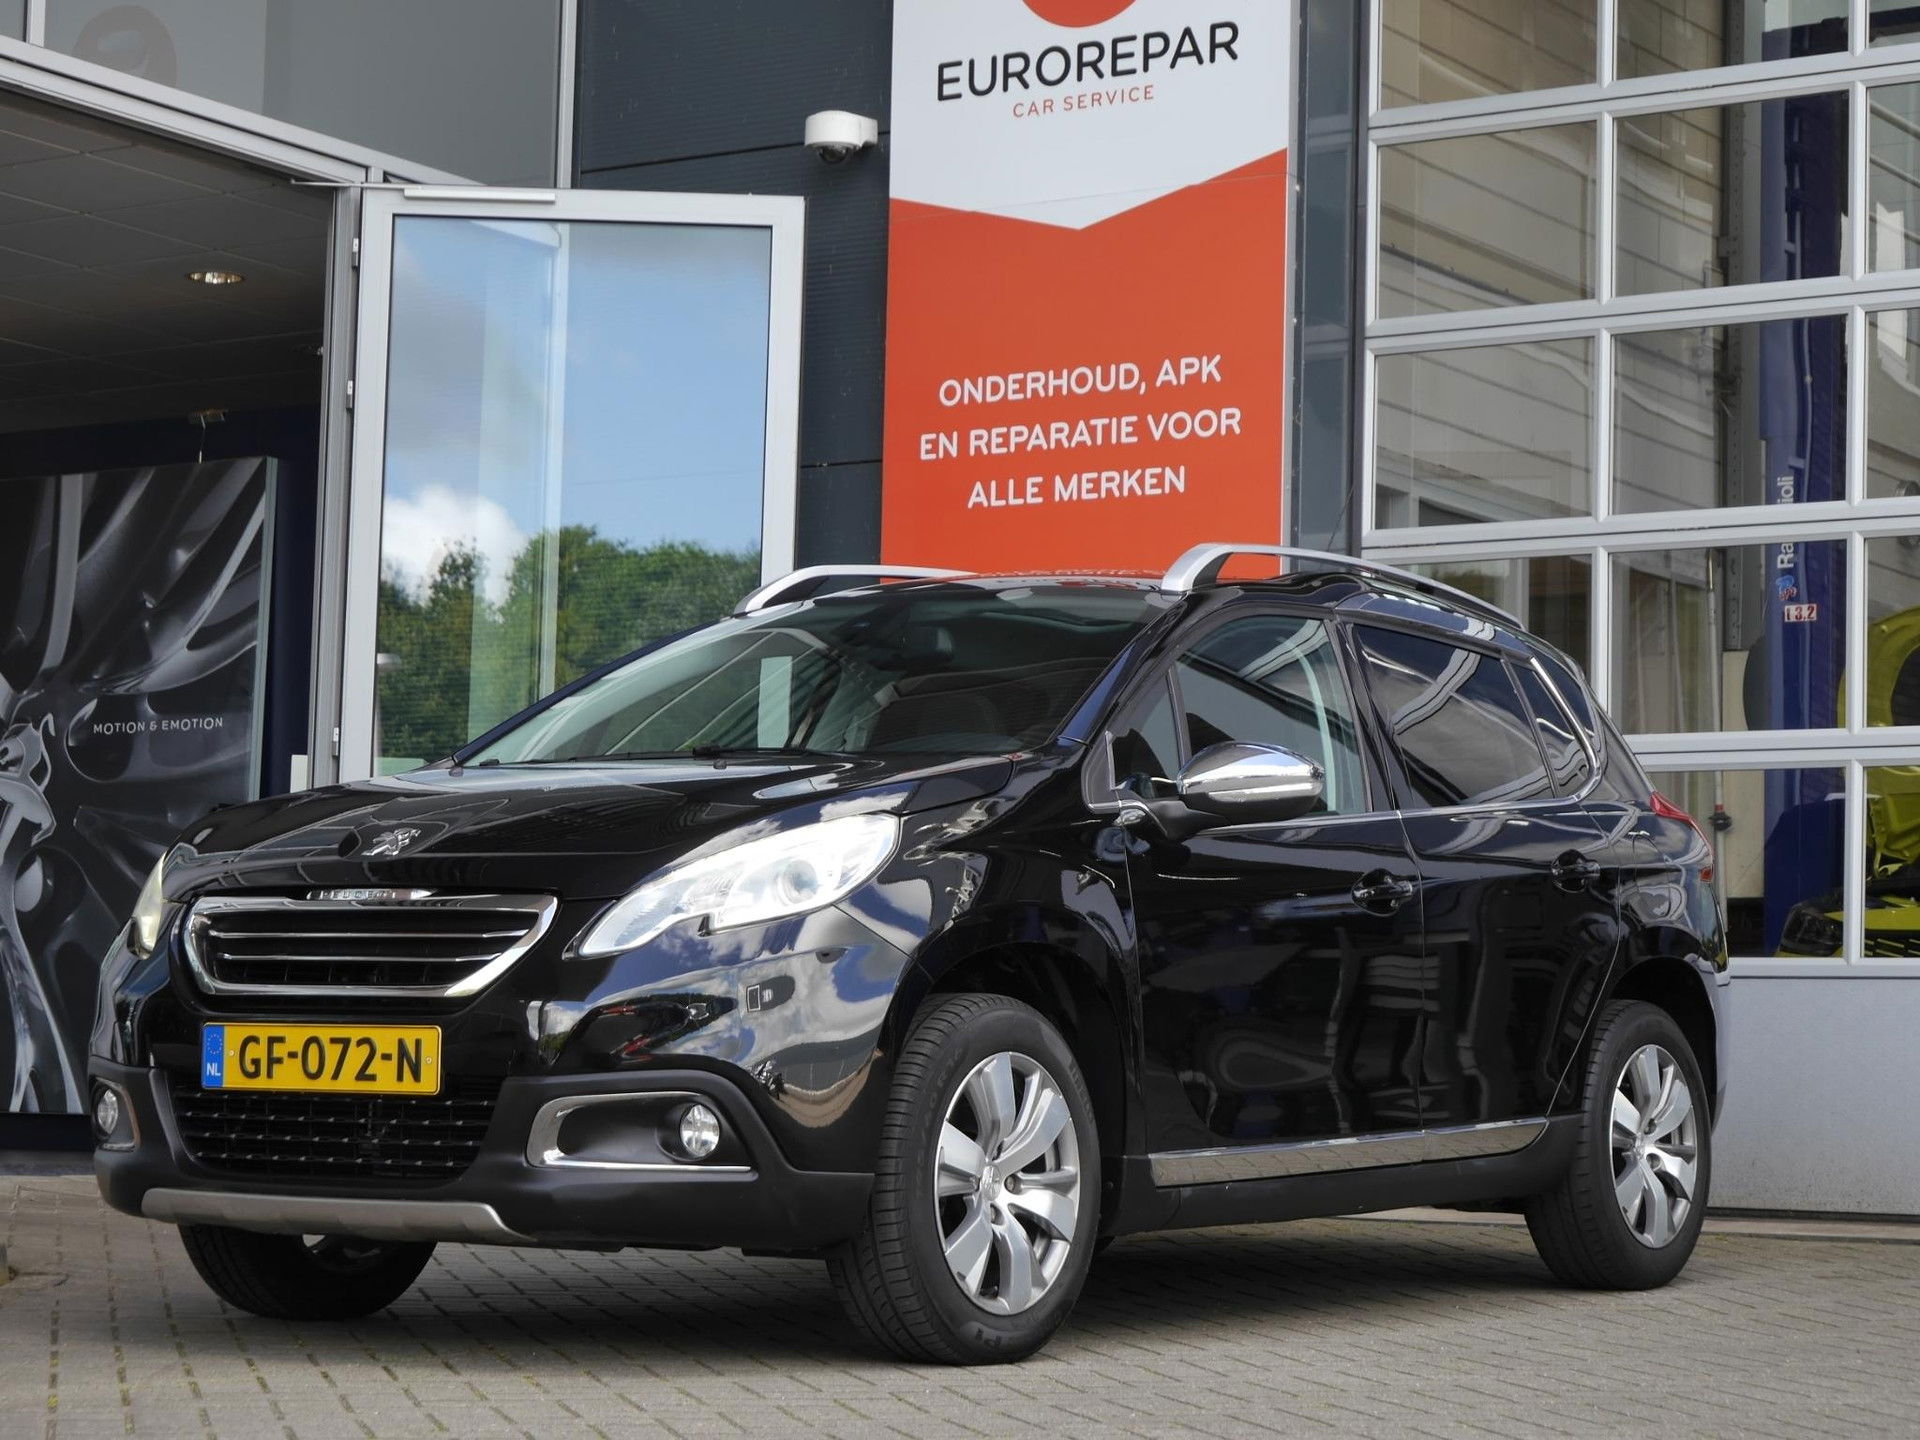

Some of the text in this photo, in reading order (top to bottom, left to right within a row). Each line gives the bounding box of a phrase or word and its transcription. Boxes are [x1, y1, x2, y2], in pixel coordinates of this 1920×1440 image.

[938, 21, 1239, 101] EUROREPAR
[1013, 85, 1154, 118] CAR SERVICE
[939, 354, 1221, 407] ONDERHOUD, APK
[920, 407, 1241, 460] EN REPARATIE VOOR
[967, 465, 1186, 509] ALLE MERKEN
[93, 717, 223, 734] MOTION & EMOTION
[206, 1062, 221, 1077] NL
[238, 1035, 422, 1083] GF-072-N
